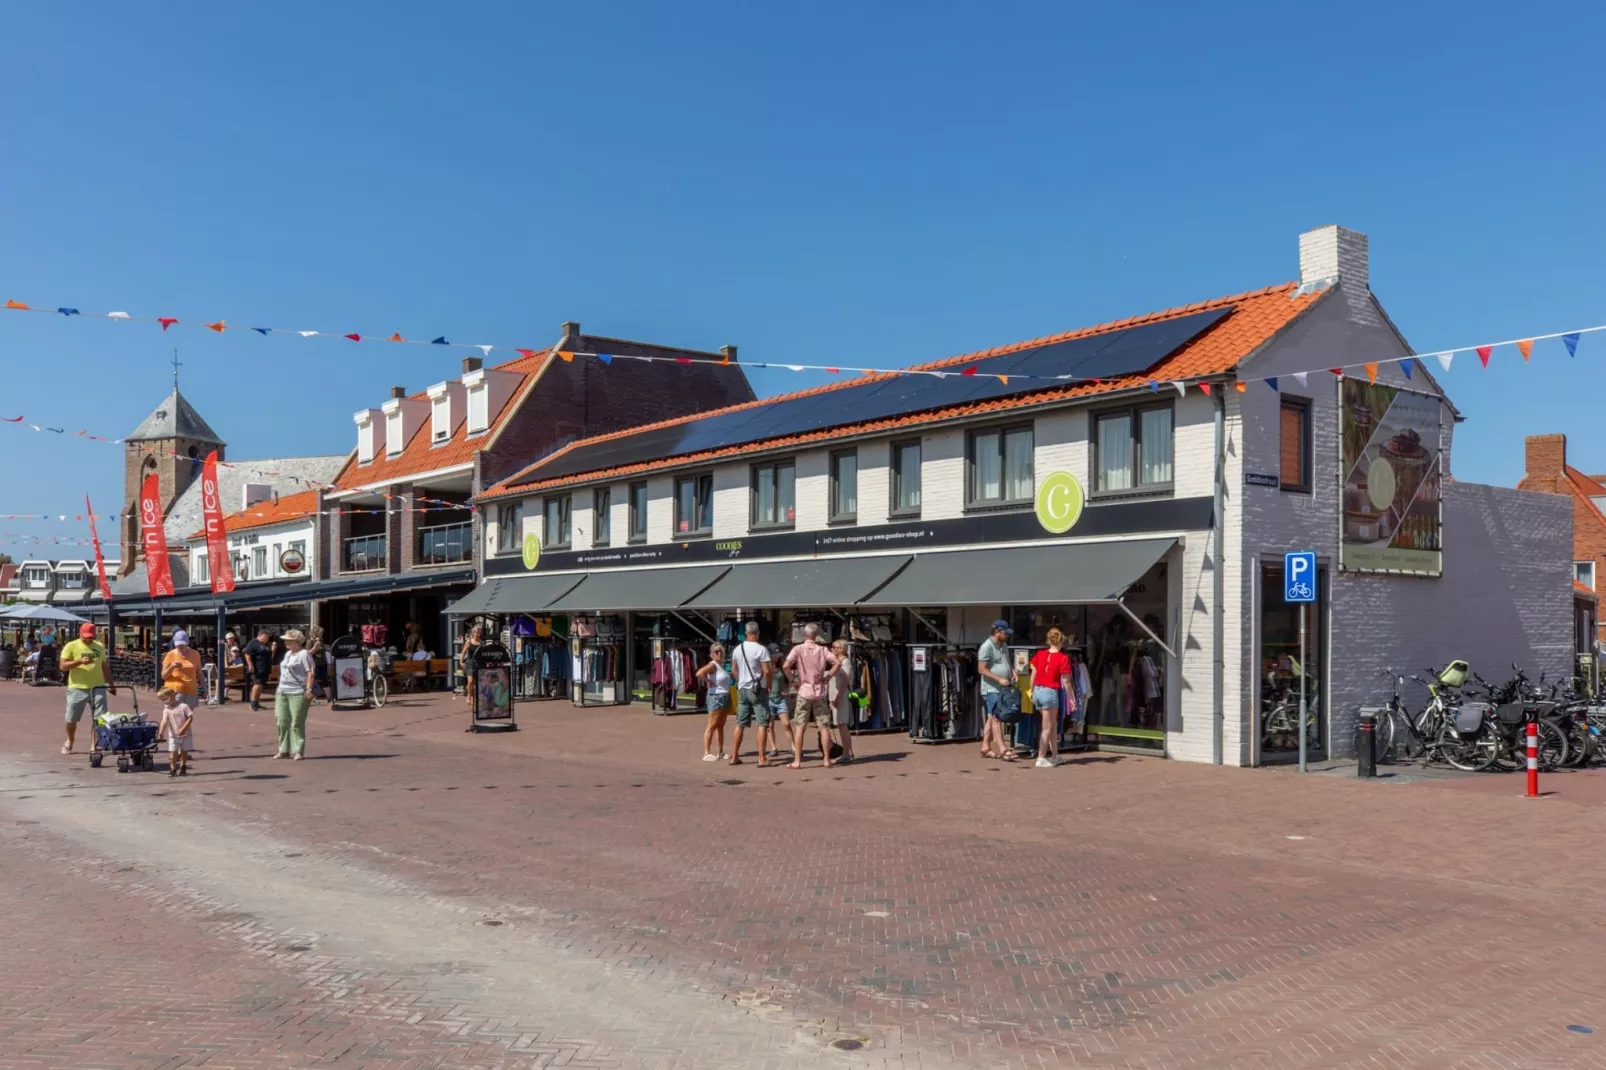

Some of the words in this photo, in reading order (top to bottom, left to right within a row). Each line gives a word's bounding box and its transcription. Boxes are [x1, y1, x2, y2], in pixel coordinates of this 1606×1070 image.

[204, 479, 217, 514] Ice
[142, 498, 157, 528] Ice
[874, 530, 925, 540] www.goodies-shop.nl
[1292, 557, 1308, 582] P
